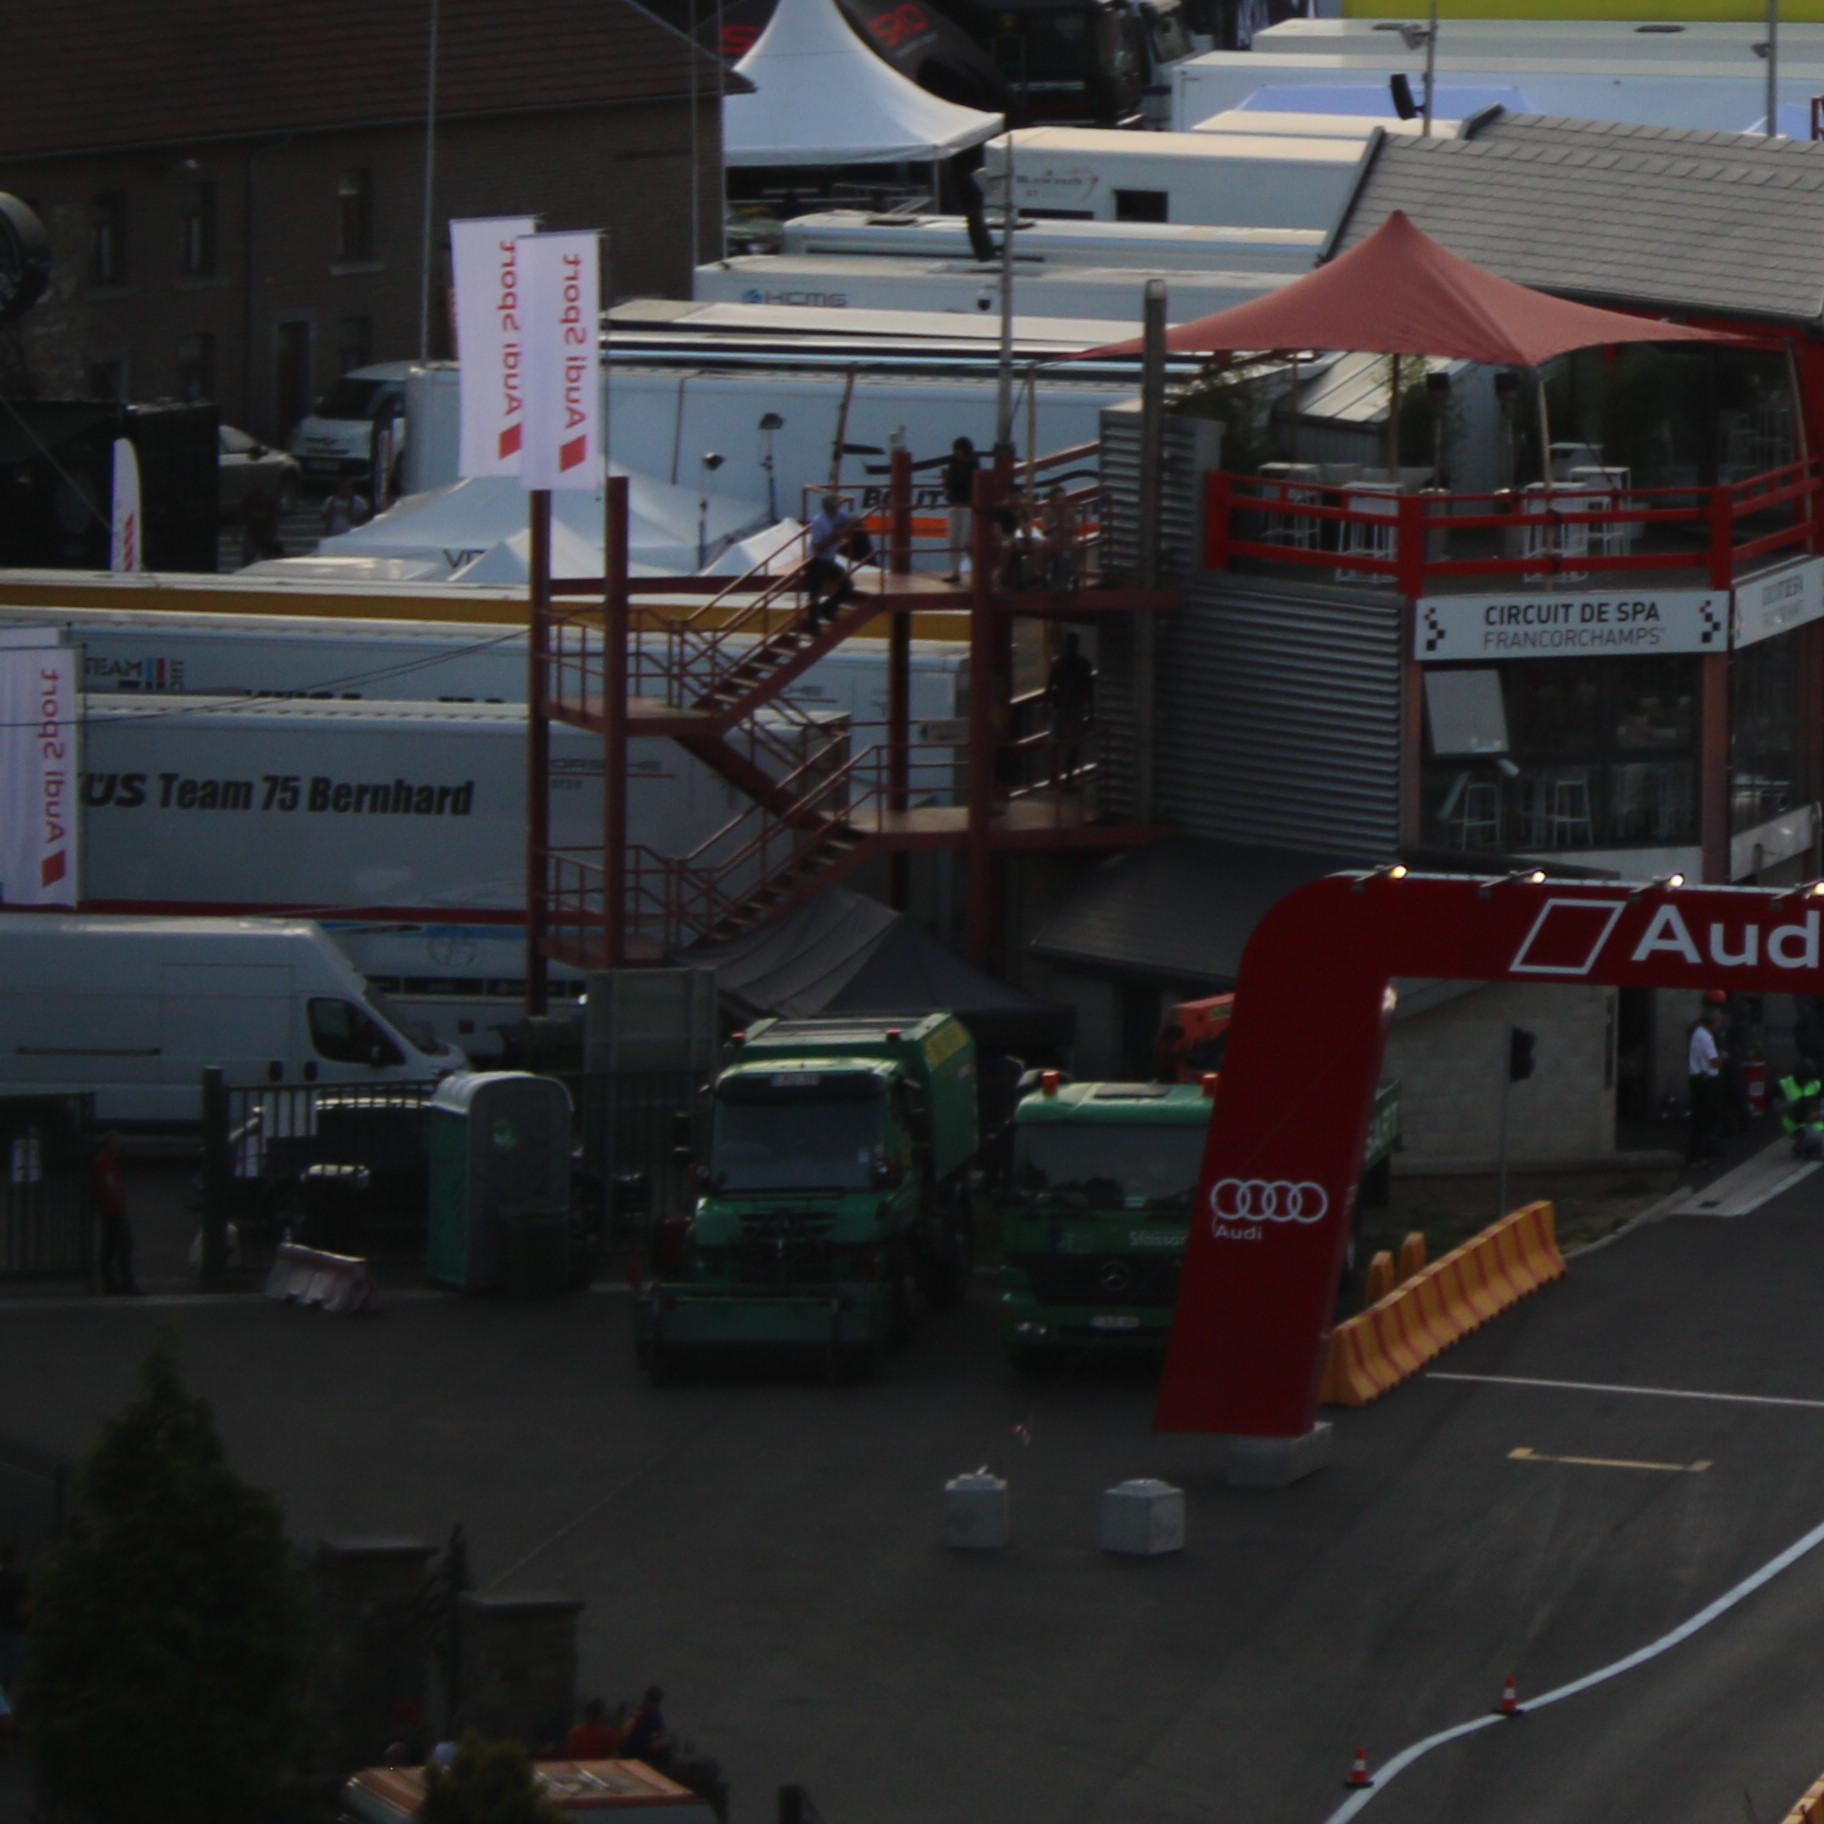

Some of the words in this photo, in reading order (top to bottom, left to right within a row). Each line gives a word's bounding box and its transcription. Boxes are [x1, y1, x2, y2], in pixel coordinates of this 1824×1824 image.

[1484, 604, 1573, 626] CIRCUIT
[1580, 603, 1613, 623] DE
[1616, 601, 1661, 623] SPA
[1484, 627, 1664, 650] FRANCORCHAMPS
[80, 773, 147, 808] ÜS
[157, 773, 252, 811] Team
[261, 775, 302, 811] 75
[307, 776, 475, 816] Bernhard
[1213, 1223, 1263, 1242] Audi
